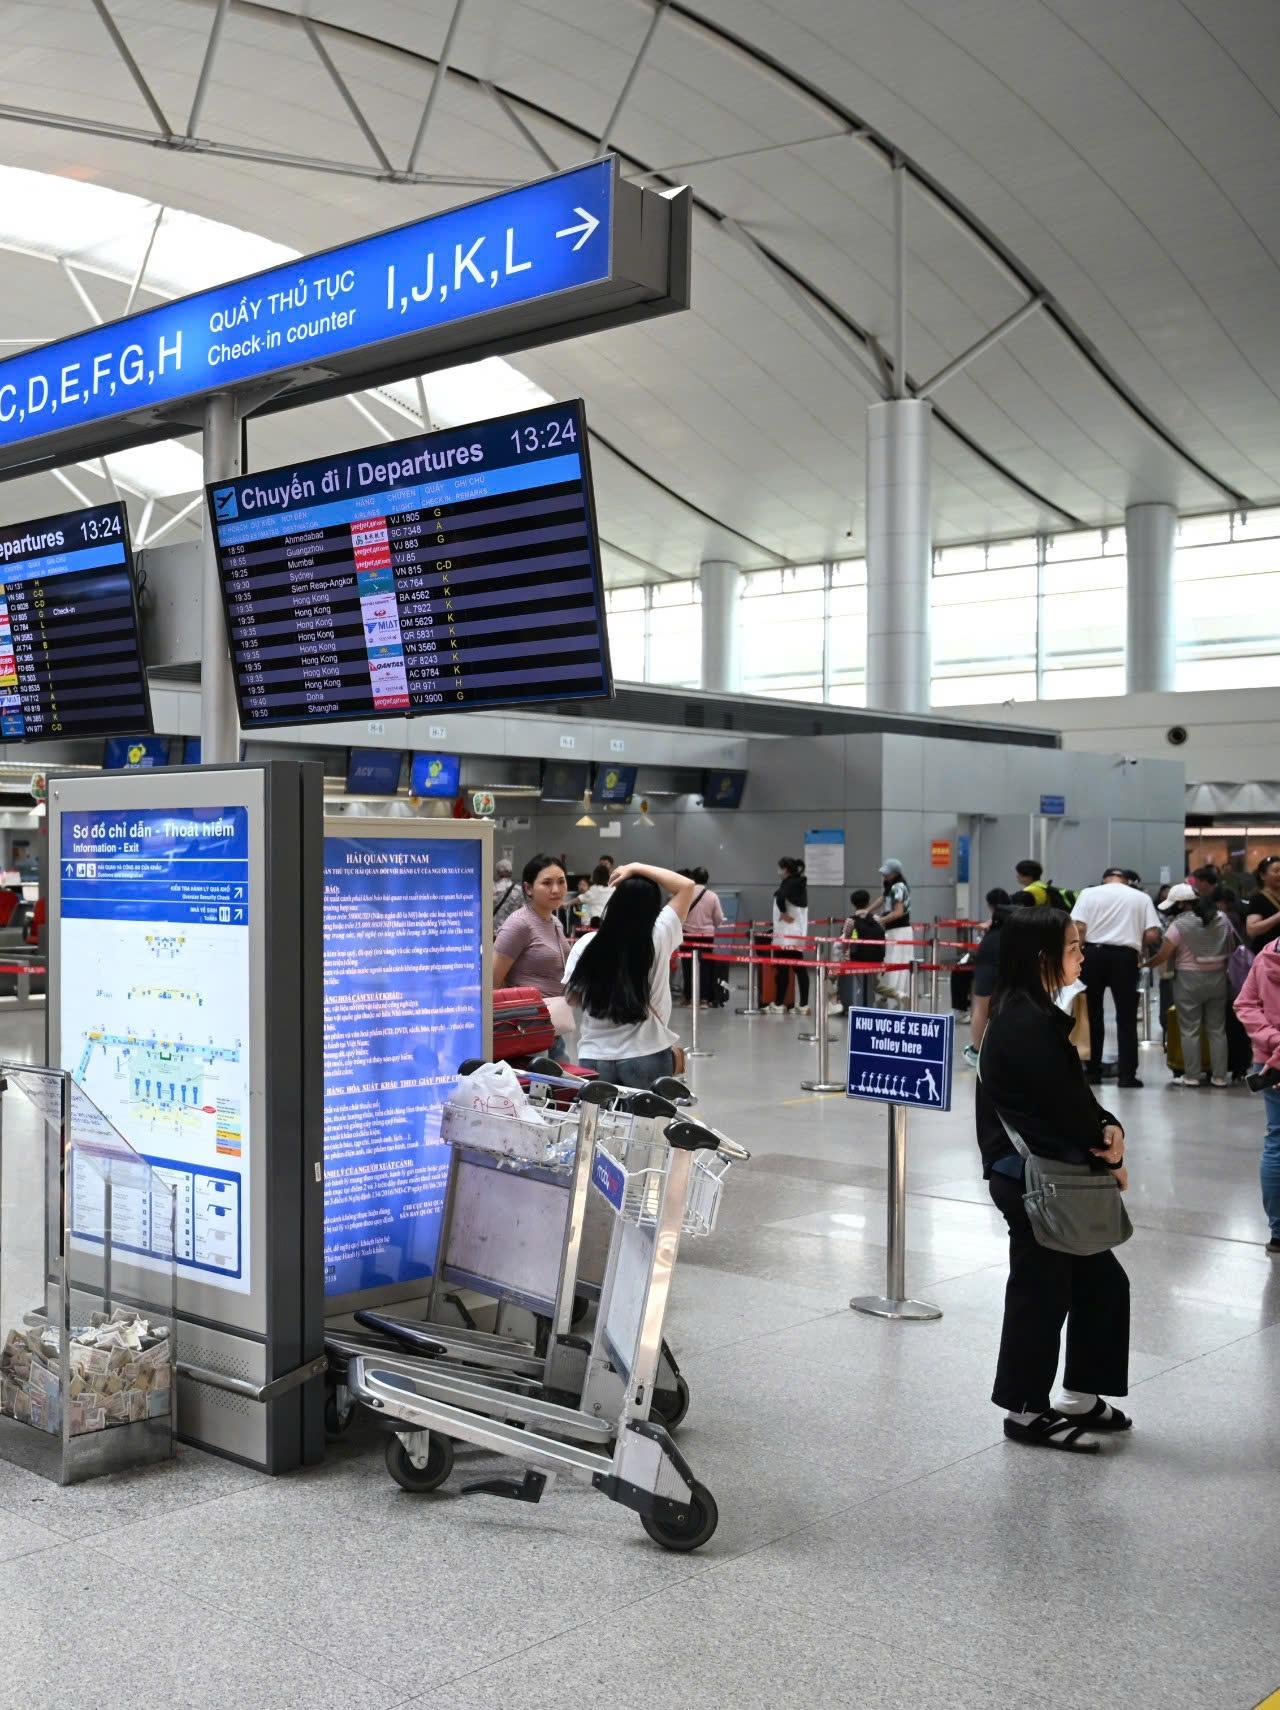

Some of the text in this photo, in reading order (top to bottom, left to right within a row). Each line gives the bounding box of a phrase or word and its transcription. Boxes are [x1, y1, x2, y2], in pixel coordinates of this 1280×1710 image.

[386, 228, 532, 314] I,J,K,L
[209, 269, 355, 333] QUẦY THỦ TỤC
[207, 308, 356, 366] Check-in counter
[510, 418, 577, 455] 13:24
[241, 443, 484, 511] Chuyến đi / Departures
[80, 515, 121, 541] 13:24
[228, 508, 441, 555] 18:50 Ahmedabad VJ 1805 G
[230, 556, 247, 568] 18:55
[286, 544, 324, 557] Guangzhou
[436, 521, 443, 530] A
[231, 534, 444, 580] 19:25 Mumbai VJ 883 G
[233, 552, 416, 592] 19:30 Sydney VJ 85
[235, 560, 452, 602] 19:35 Siem Reap-Angkor VN 815 C-D
[236, 574, 449, 614] 19:35 Hong Kong CX 764 K
[52, 606, 76, 616] Check-in
[238, 587, 451, 626] 19:35 Hong Kong BA 4562 K
[239, 600, 453, 637] 19:35 Hong Kong JL 7922 K
[241, 639, 259, 649] 19:35
[297, 632, 316, 643] Hong
[316, 630, 335, 641] Kong
[400, 619, 414, 628] OM
[414, 616, 433, 627] 5629
[447, 613, 455, 623] K
[243, 626, 456, 660] 19:35 Hong Kong QR 5831 K
[245, 639, 458, 672] 19:35 Hong Kong VN 3560 K
[246, 674, 264, 684] 19:35
[302, 668, 321, 679] Hong
[321, 666, 340, 677] Kong
[407, 657, 419, 667] QF
[419, 654, 438, 665] 8243
[452, 652, 460, 662] K
[248, 665, 461, 696] 19:35 Hong Kong AC 9784 K
[409, 682, 421, 692] QR
[422, 680, 437, 691] 971
[455, 678, 462, 688] H
[251, 691, 464, 719] 19:50 Shanghai VJ 3900 G
[73, 824, 88, 839] Sơ
[91, 822, 106, 839] đồ
[108, 822, 127, 838] chỉ
[129, 820, 152, 838] dẫn
[163, 822, 199, 838] Thoát
[202, 818, 234, 838] hiểm
[73, 843, 117, 853] Information
[123, 843, 139, 853] Exit
[346, 851, 429, 866] HẢI QUAN VIỆT NAM
[855, 1016, 940, 1038] KHU VỰC ĐỂ XE ĐẨY
[871, 1036, 922, 1055] Trolley here
